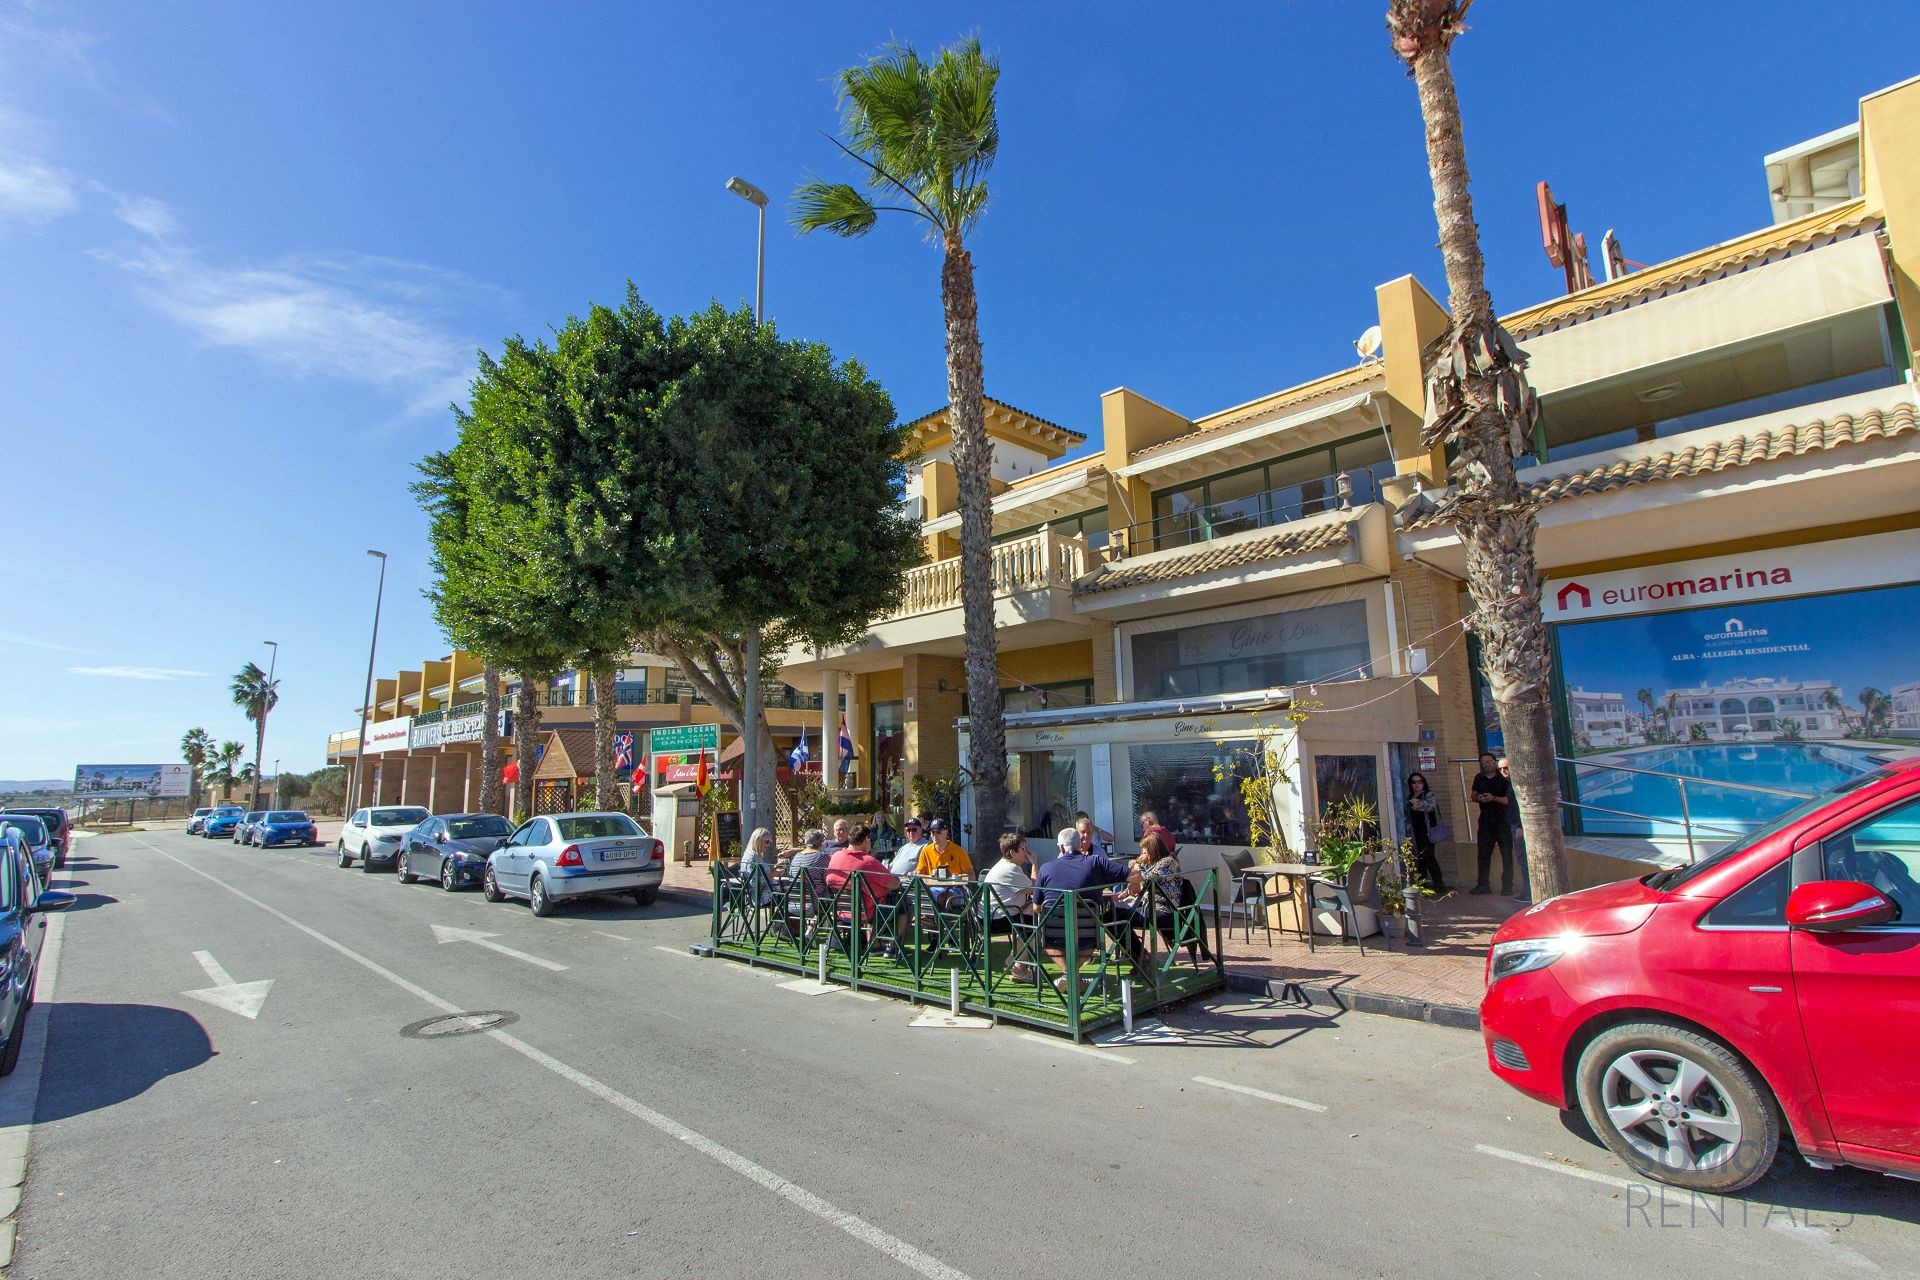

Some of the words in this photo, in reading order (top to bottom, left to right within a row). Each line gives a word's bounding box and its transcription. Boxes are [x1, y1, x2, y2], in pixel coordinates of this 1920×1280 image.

[1602, 566, 1793, 605] euromarina
[1228, 625, 1273, 657] Gino
[1703, 628, 1768, 641] euromarina
[1701, 649, 1743, 659] ALLEGRA
[1745, 643, 1811, 655] RESIDENTIAL
[652, 728, 682, 737] INDIAN
[687, 725, 716, 734] OCEAN
[1174, 720, 1194, 737] Gino
[661, 737, 709, 746] GARDEN
[1035, 730, 1050, 744] Gino
